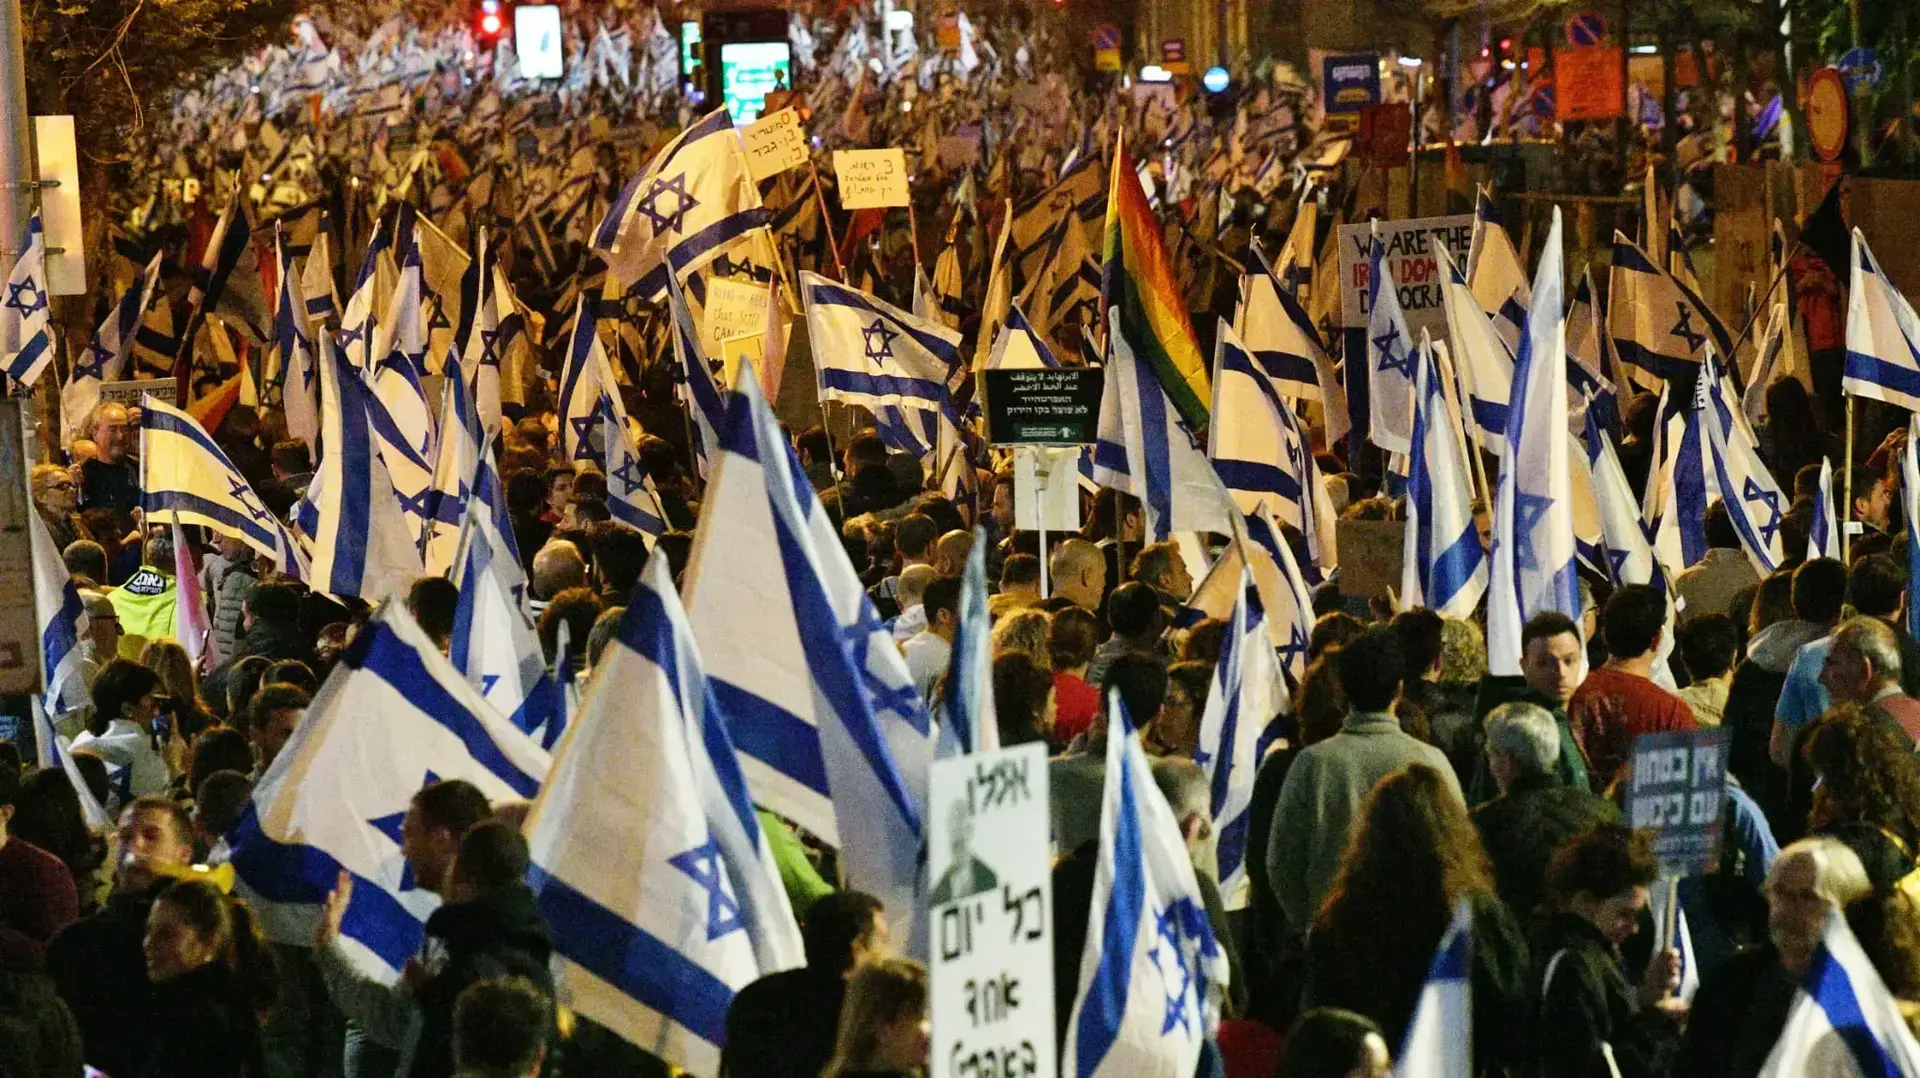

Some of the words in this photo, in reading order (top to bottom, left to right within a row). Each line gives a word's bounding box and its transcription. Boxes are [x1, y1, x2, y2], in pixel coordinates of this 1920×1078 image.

[1387, 229, 1428, 256] ARE
[1430, 226, 1471, 251] THE
[1401, 259, 1438, 283] DOM
[1006, 406, 1032, 417] הירוק
[1034, 406, 1050, 416] בקו
[1074, 404, 1088, 415] לא
[1003, 882, 1043, 942] כל
[941, 901, 984, 963] יום
[963, 971, 1021, 1029] אחד
